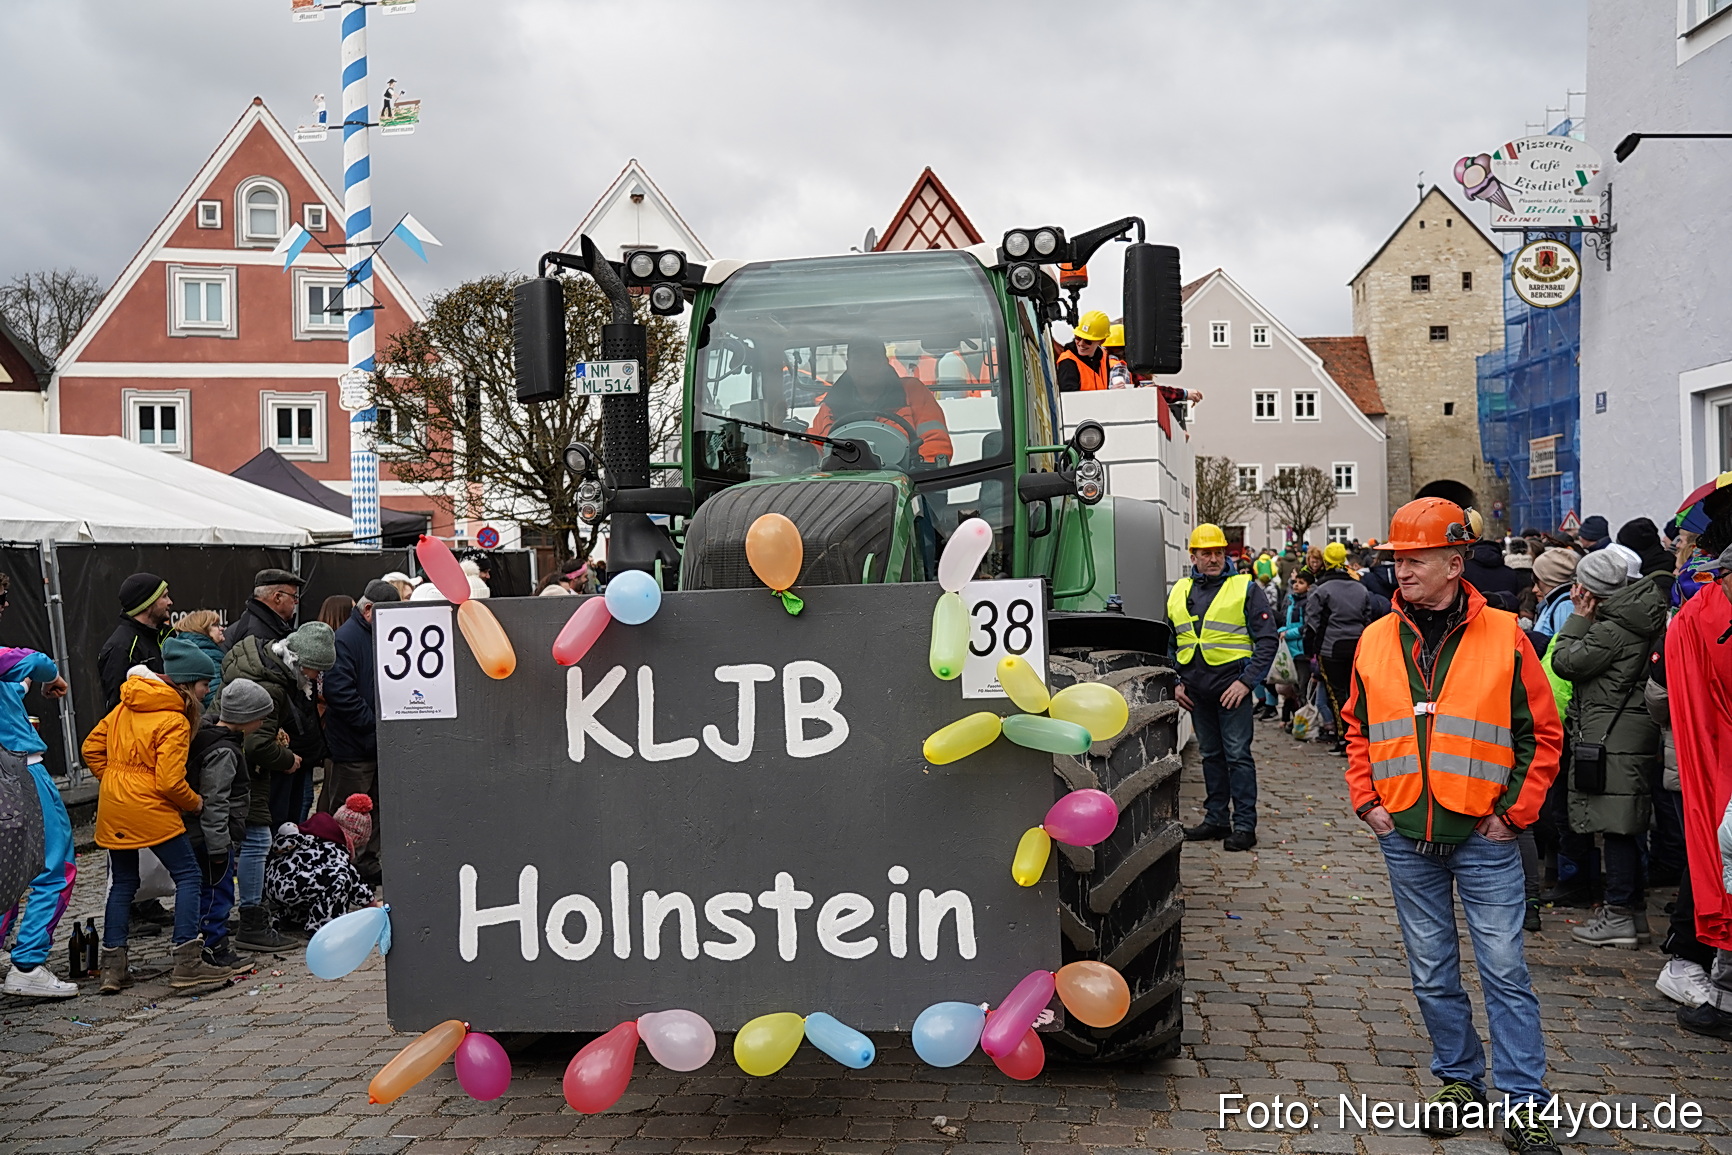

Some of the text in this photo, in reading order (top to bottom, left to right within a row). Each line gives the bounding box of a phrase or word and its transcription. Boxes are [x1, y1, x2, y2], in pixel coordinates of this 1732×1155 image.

[1516, 140, 1574, 154] Pizzeria
[1530, 159, 1560, 172] Café
[1514, 176, 1575, 192] Eisdiele
[590, 364, 610, 378] NM
[583, 377, 632, 393] ML 514
[968, 599, 1034, 657] 38
[383, 625, 445, 680] 38
[566, 660, 850, 762] KLJB
[459, 860, 977, 962] Holnstein
